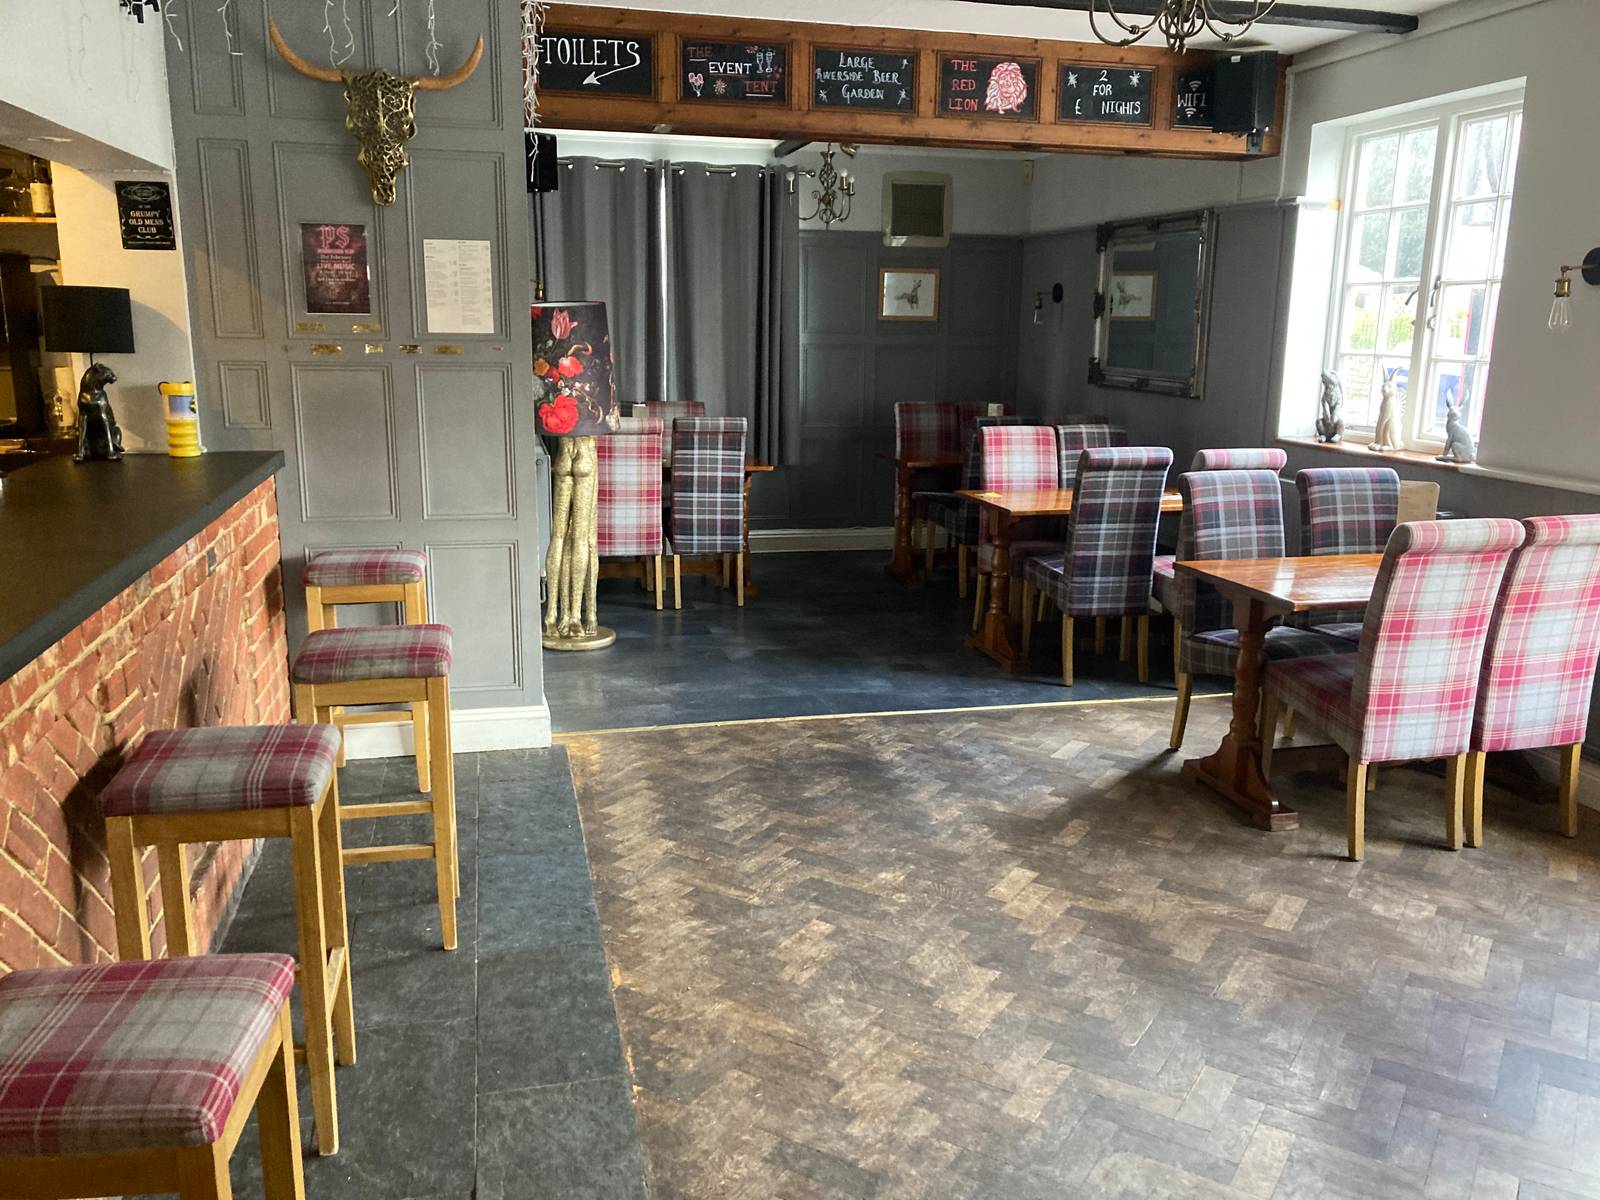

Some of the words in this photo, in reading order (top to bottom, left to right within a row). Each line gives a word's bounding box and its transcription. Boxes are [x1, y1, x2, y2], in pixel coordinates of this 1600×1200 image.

[541, 37, 641, 67] TOILETS
[687, 47, 712, 58] THE
[709, 61, 752, 75] EVENT
[839, 52, 876, 72] LARGE
[951, 59, 977, 71] THE
[872, 69, 902, 84] BEER
[1099, 69, 1108, 82] 2
[744, 79, 778, 93] TENT
[951, 79, 976, 91] RED
[1093, 84, 1112, 96] FOR
[841, 83, 884, 104] GARDEN
[1177, 93, 1208, 107] WIFI
[948, 98, 979, 111] LION
[1101, 100, 1141, 115] NIGHTS
